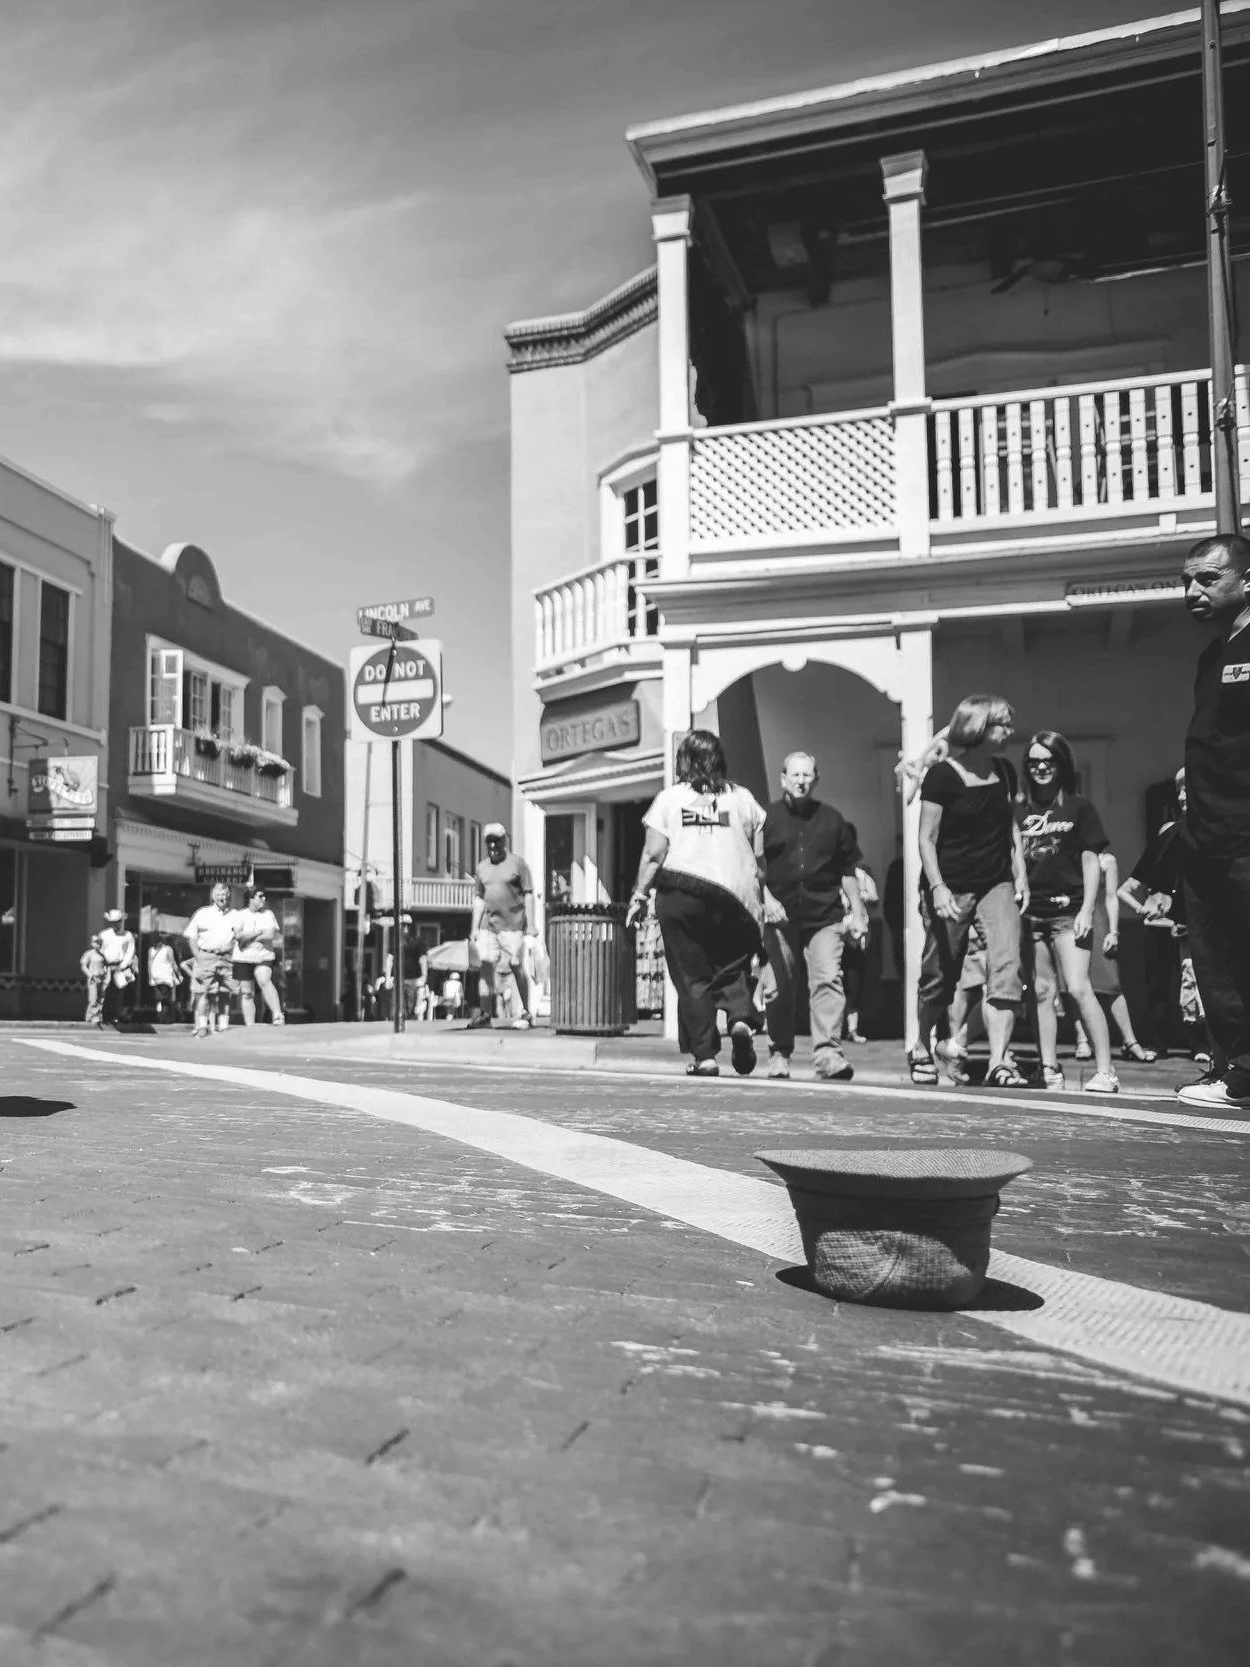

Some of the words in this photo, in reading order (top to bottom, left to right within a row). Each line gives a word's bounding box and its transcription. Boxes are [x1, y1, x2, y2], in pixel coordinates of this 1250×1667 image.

[358, 602, 410, 622] LINCOLN
[414, 599, 432, 612] AVE
[364, 664, 387, 681] DO
[394, 660, 426, 679] NOT
[370, 702, 421, 722] ENTER
